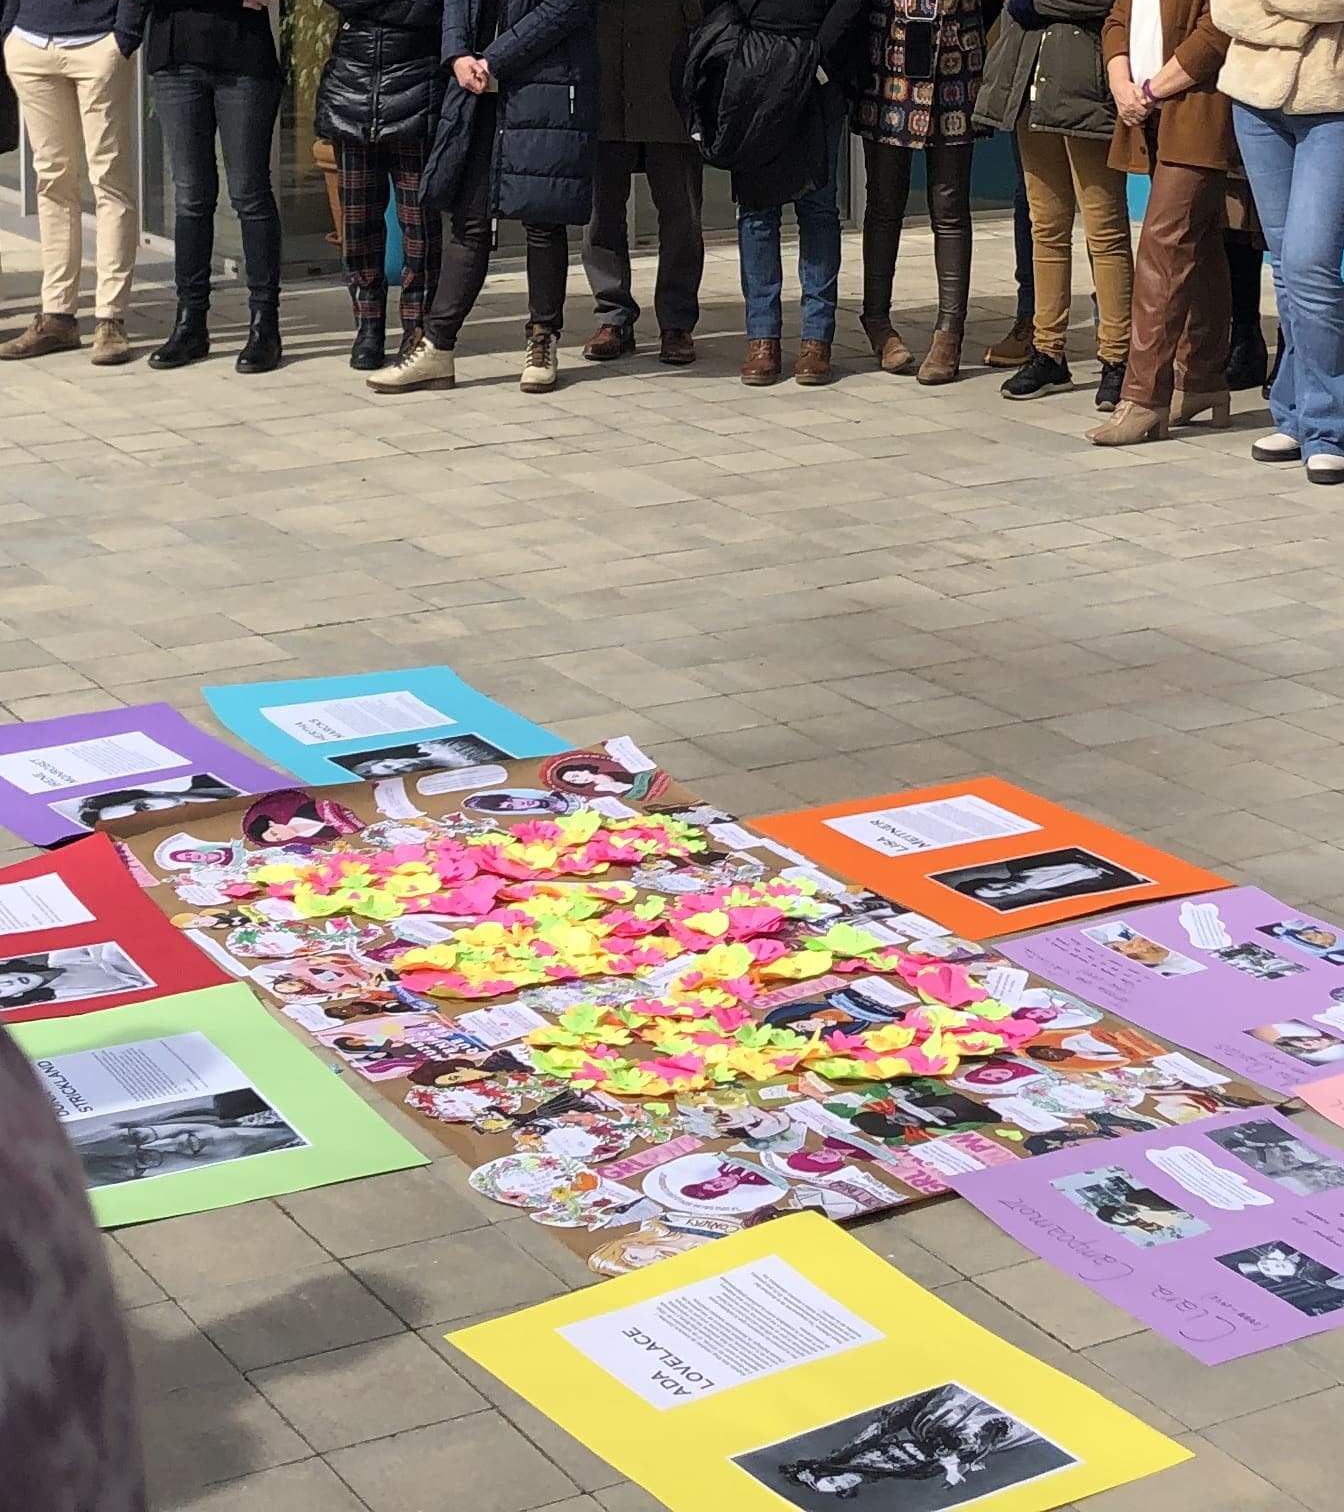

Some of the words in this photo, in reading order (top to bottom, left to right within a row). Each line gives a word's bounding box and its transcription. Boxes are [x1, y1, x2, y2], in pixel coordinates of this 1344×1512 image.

[37, 1060, 94, 1113] STRICKLAND
[1152, 1284, 1237, 1342] Clara
[622, 1326, 716, 1390] LOVELACE
[651, 1370, 692, 1395] ADA
